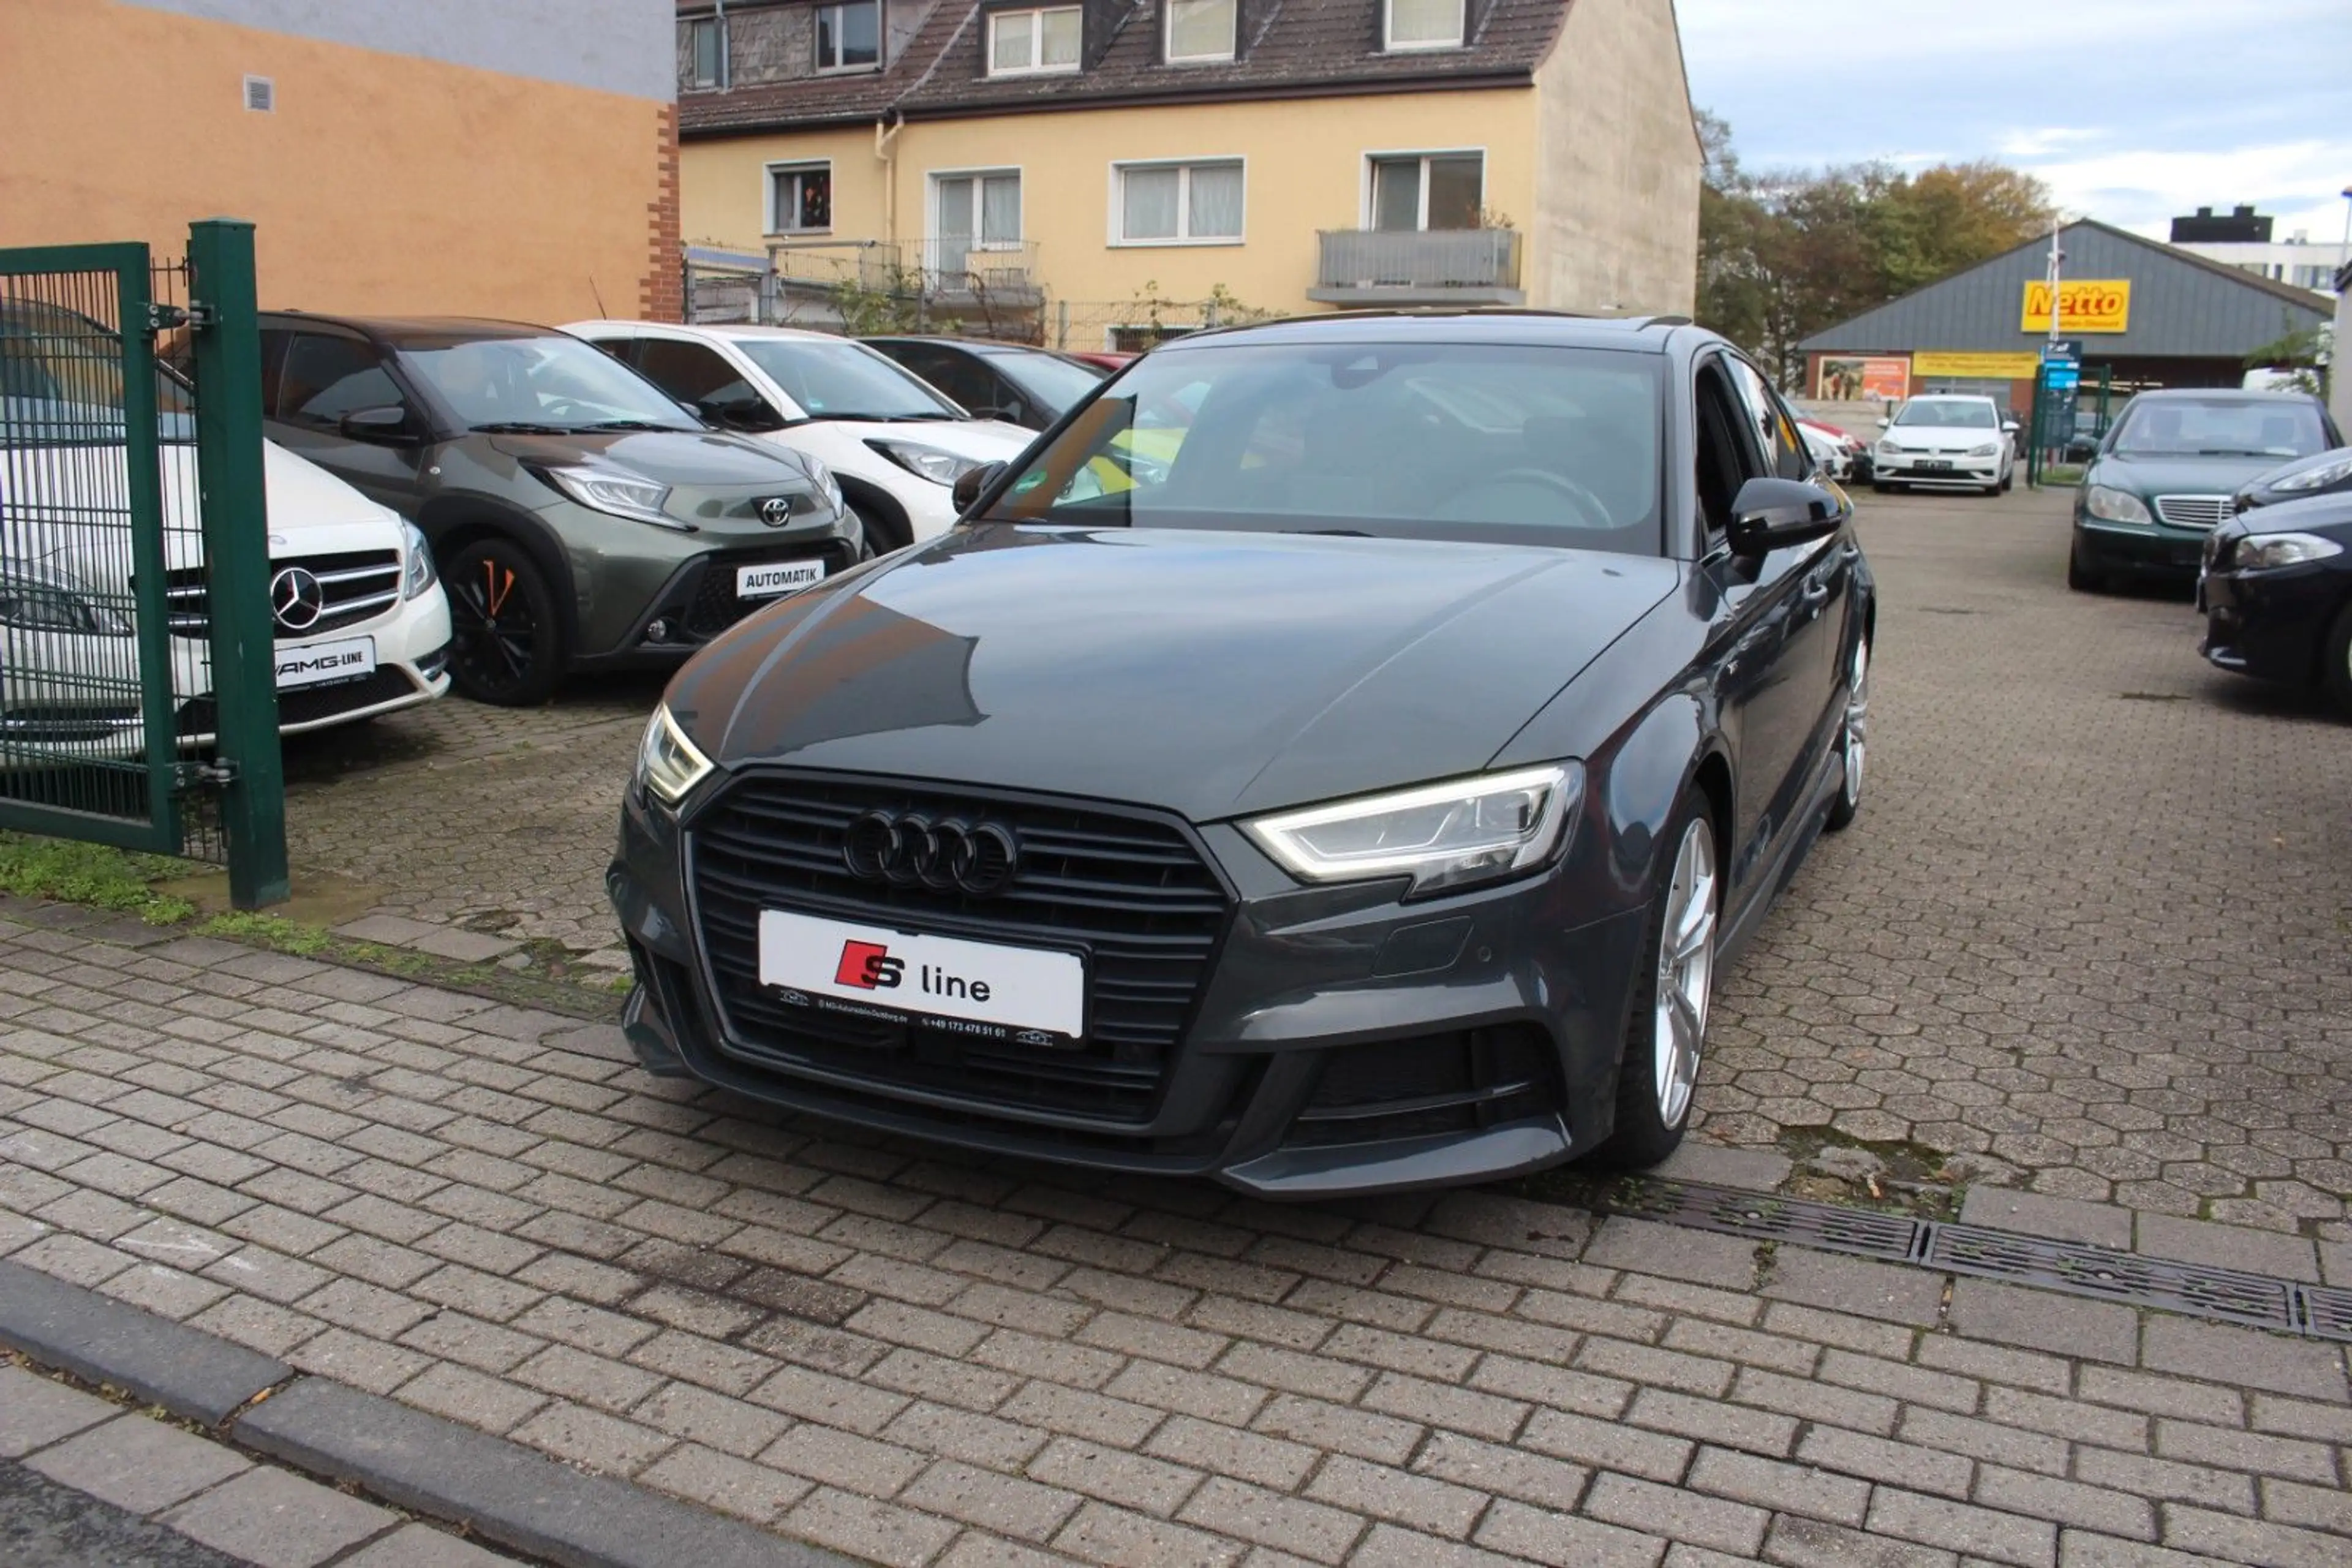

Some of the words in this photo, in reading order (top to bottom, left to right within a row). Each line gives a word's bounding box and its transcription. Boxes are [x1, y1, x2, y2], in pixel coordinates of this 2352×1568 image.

[2028, 285, 2124, 315] Netto
[746, 568, 816, 588] AUTOMATIK
[861, 954, 905, 989] S
[922, 964, 990, 1002] line
